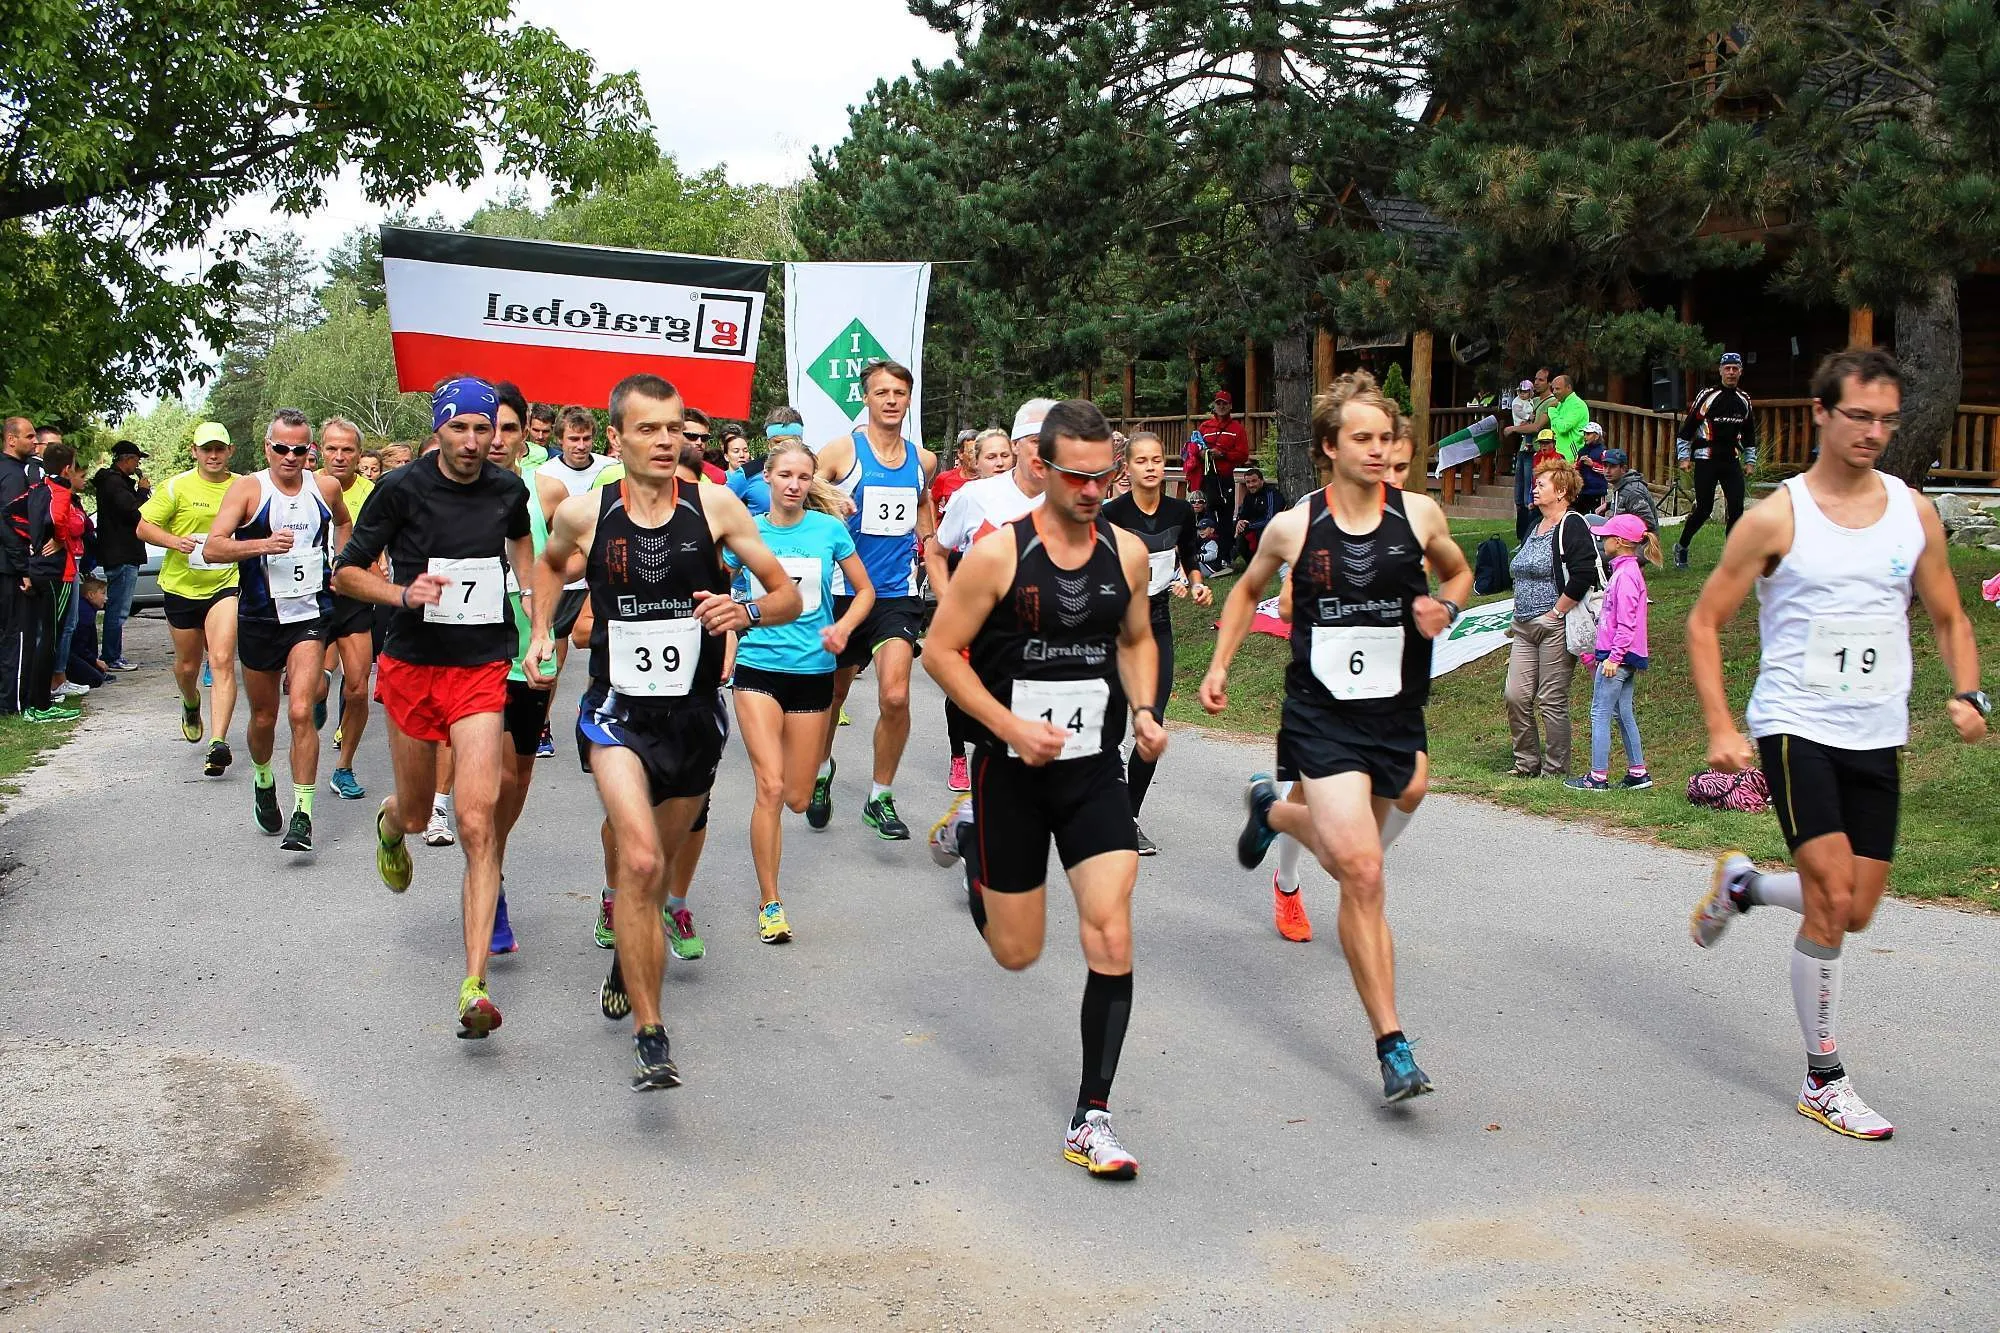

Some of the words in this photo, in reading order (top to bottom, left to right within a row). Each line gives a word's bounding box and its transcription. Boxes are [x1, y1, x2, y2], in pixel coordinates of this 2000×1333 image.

[878, 503, 905, 521] 32
[293, 565, 305, 582] 5
[461, 581, 477, 604] 7
[638, 598, 692, 613] grafobal
[1341, 597, 1403, 616] grafobal
[634, 645, 681, 673] 39
[1046, 643, 1108, 658] grafobal
[1833, 647, 1876, 674] 19
[1350, 650, 1364, 676] 6
[1040, 706, 1084, 734] 14
